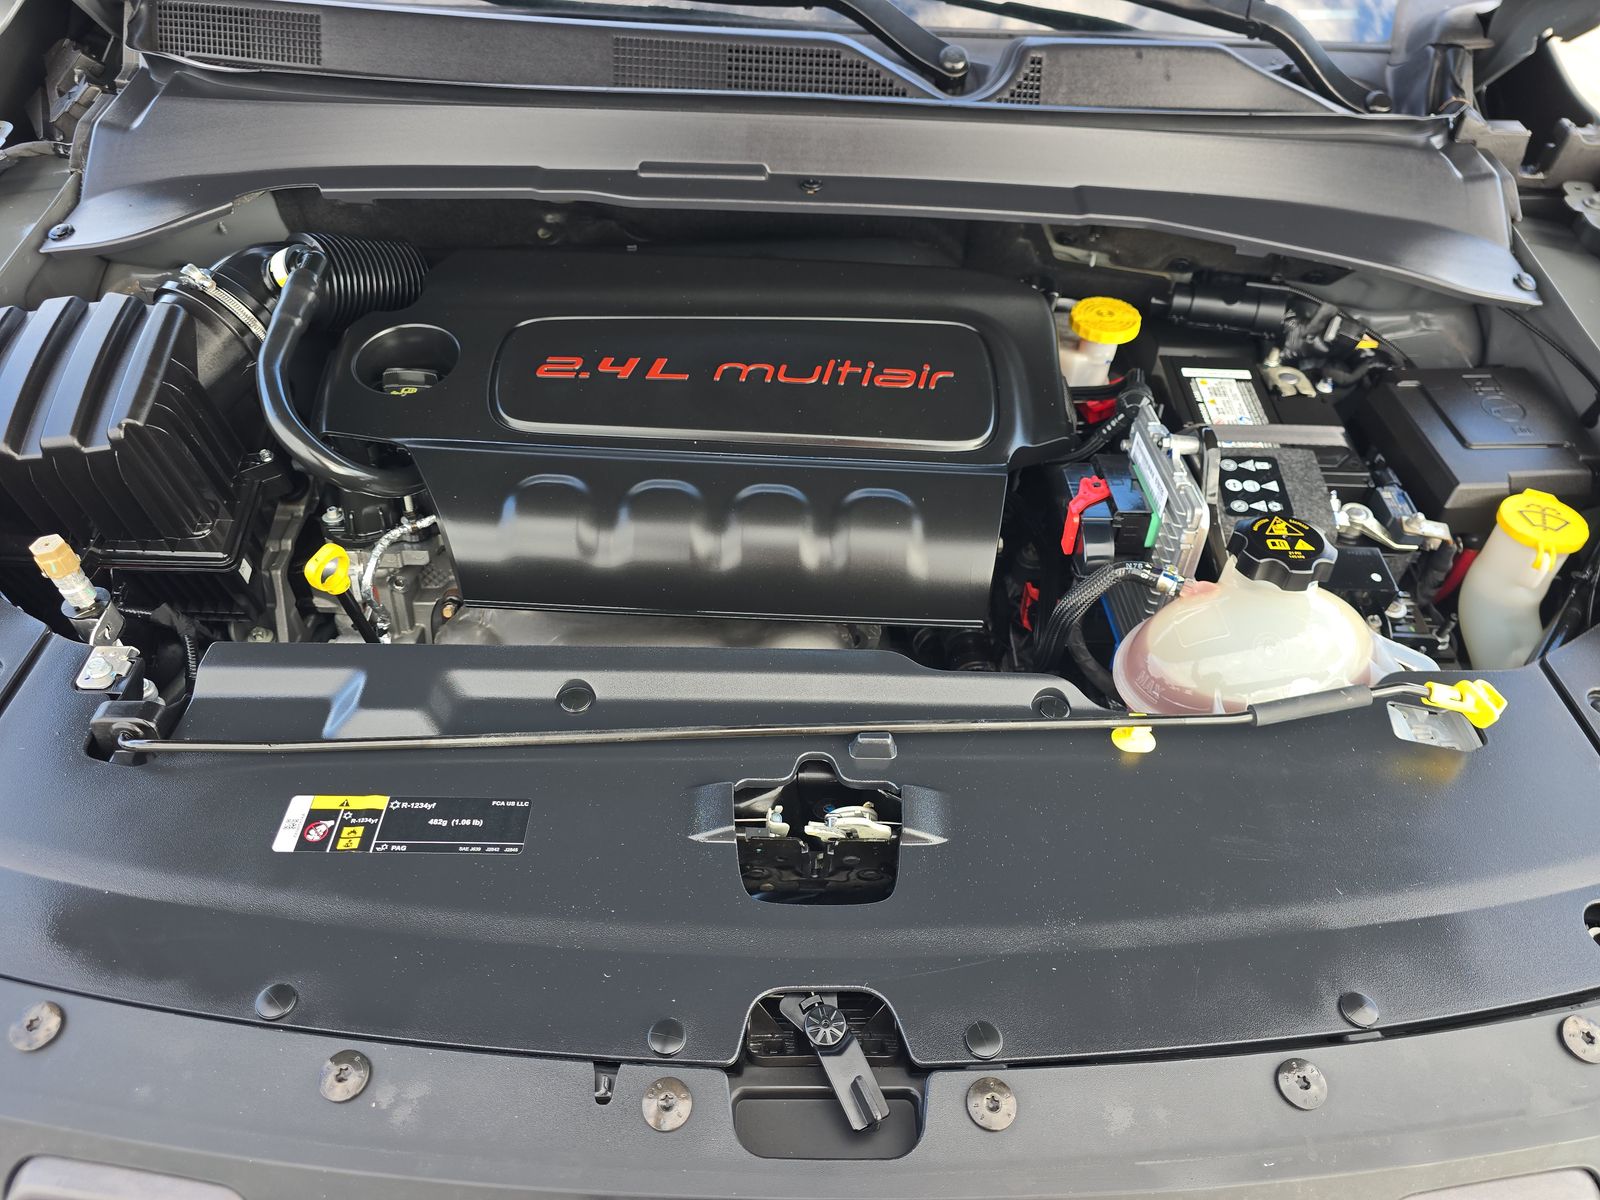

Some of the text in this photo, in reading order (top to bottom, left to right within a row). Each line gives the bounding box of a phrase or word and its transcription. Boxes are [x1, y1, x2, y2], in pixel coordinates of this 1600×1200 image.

[713, 359, 955, 389] multiair
[401, 801, 437, 810] R-1234yf
[428, 818, 484, 827] 482g (1.06 lb)
